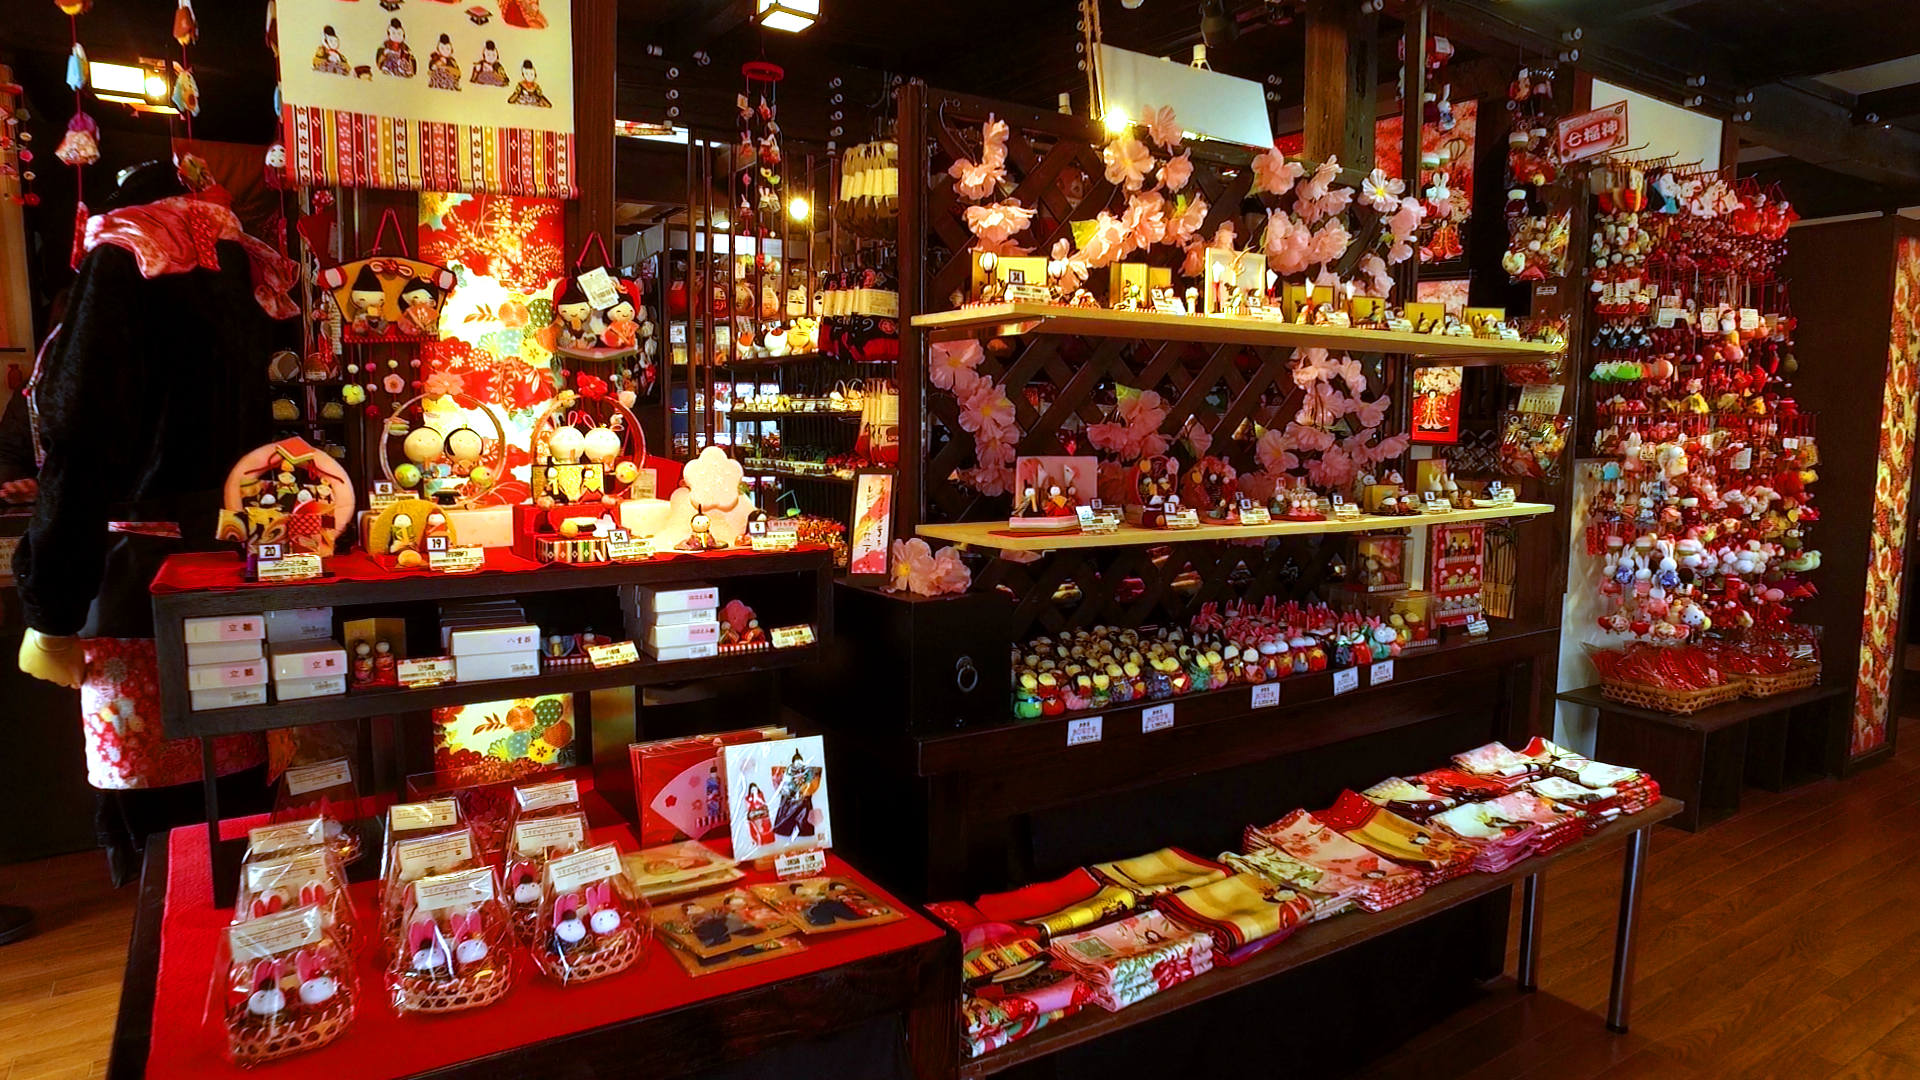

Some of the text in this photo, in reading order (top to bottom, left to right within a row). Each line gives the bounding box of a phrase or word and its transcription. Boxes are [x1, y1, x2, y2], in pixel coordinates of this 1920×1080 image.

[1565, 119, 1618, 148] 七福神
[431, 538, 442, 549] 19
[264, 545, 276, 557] 20
